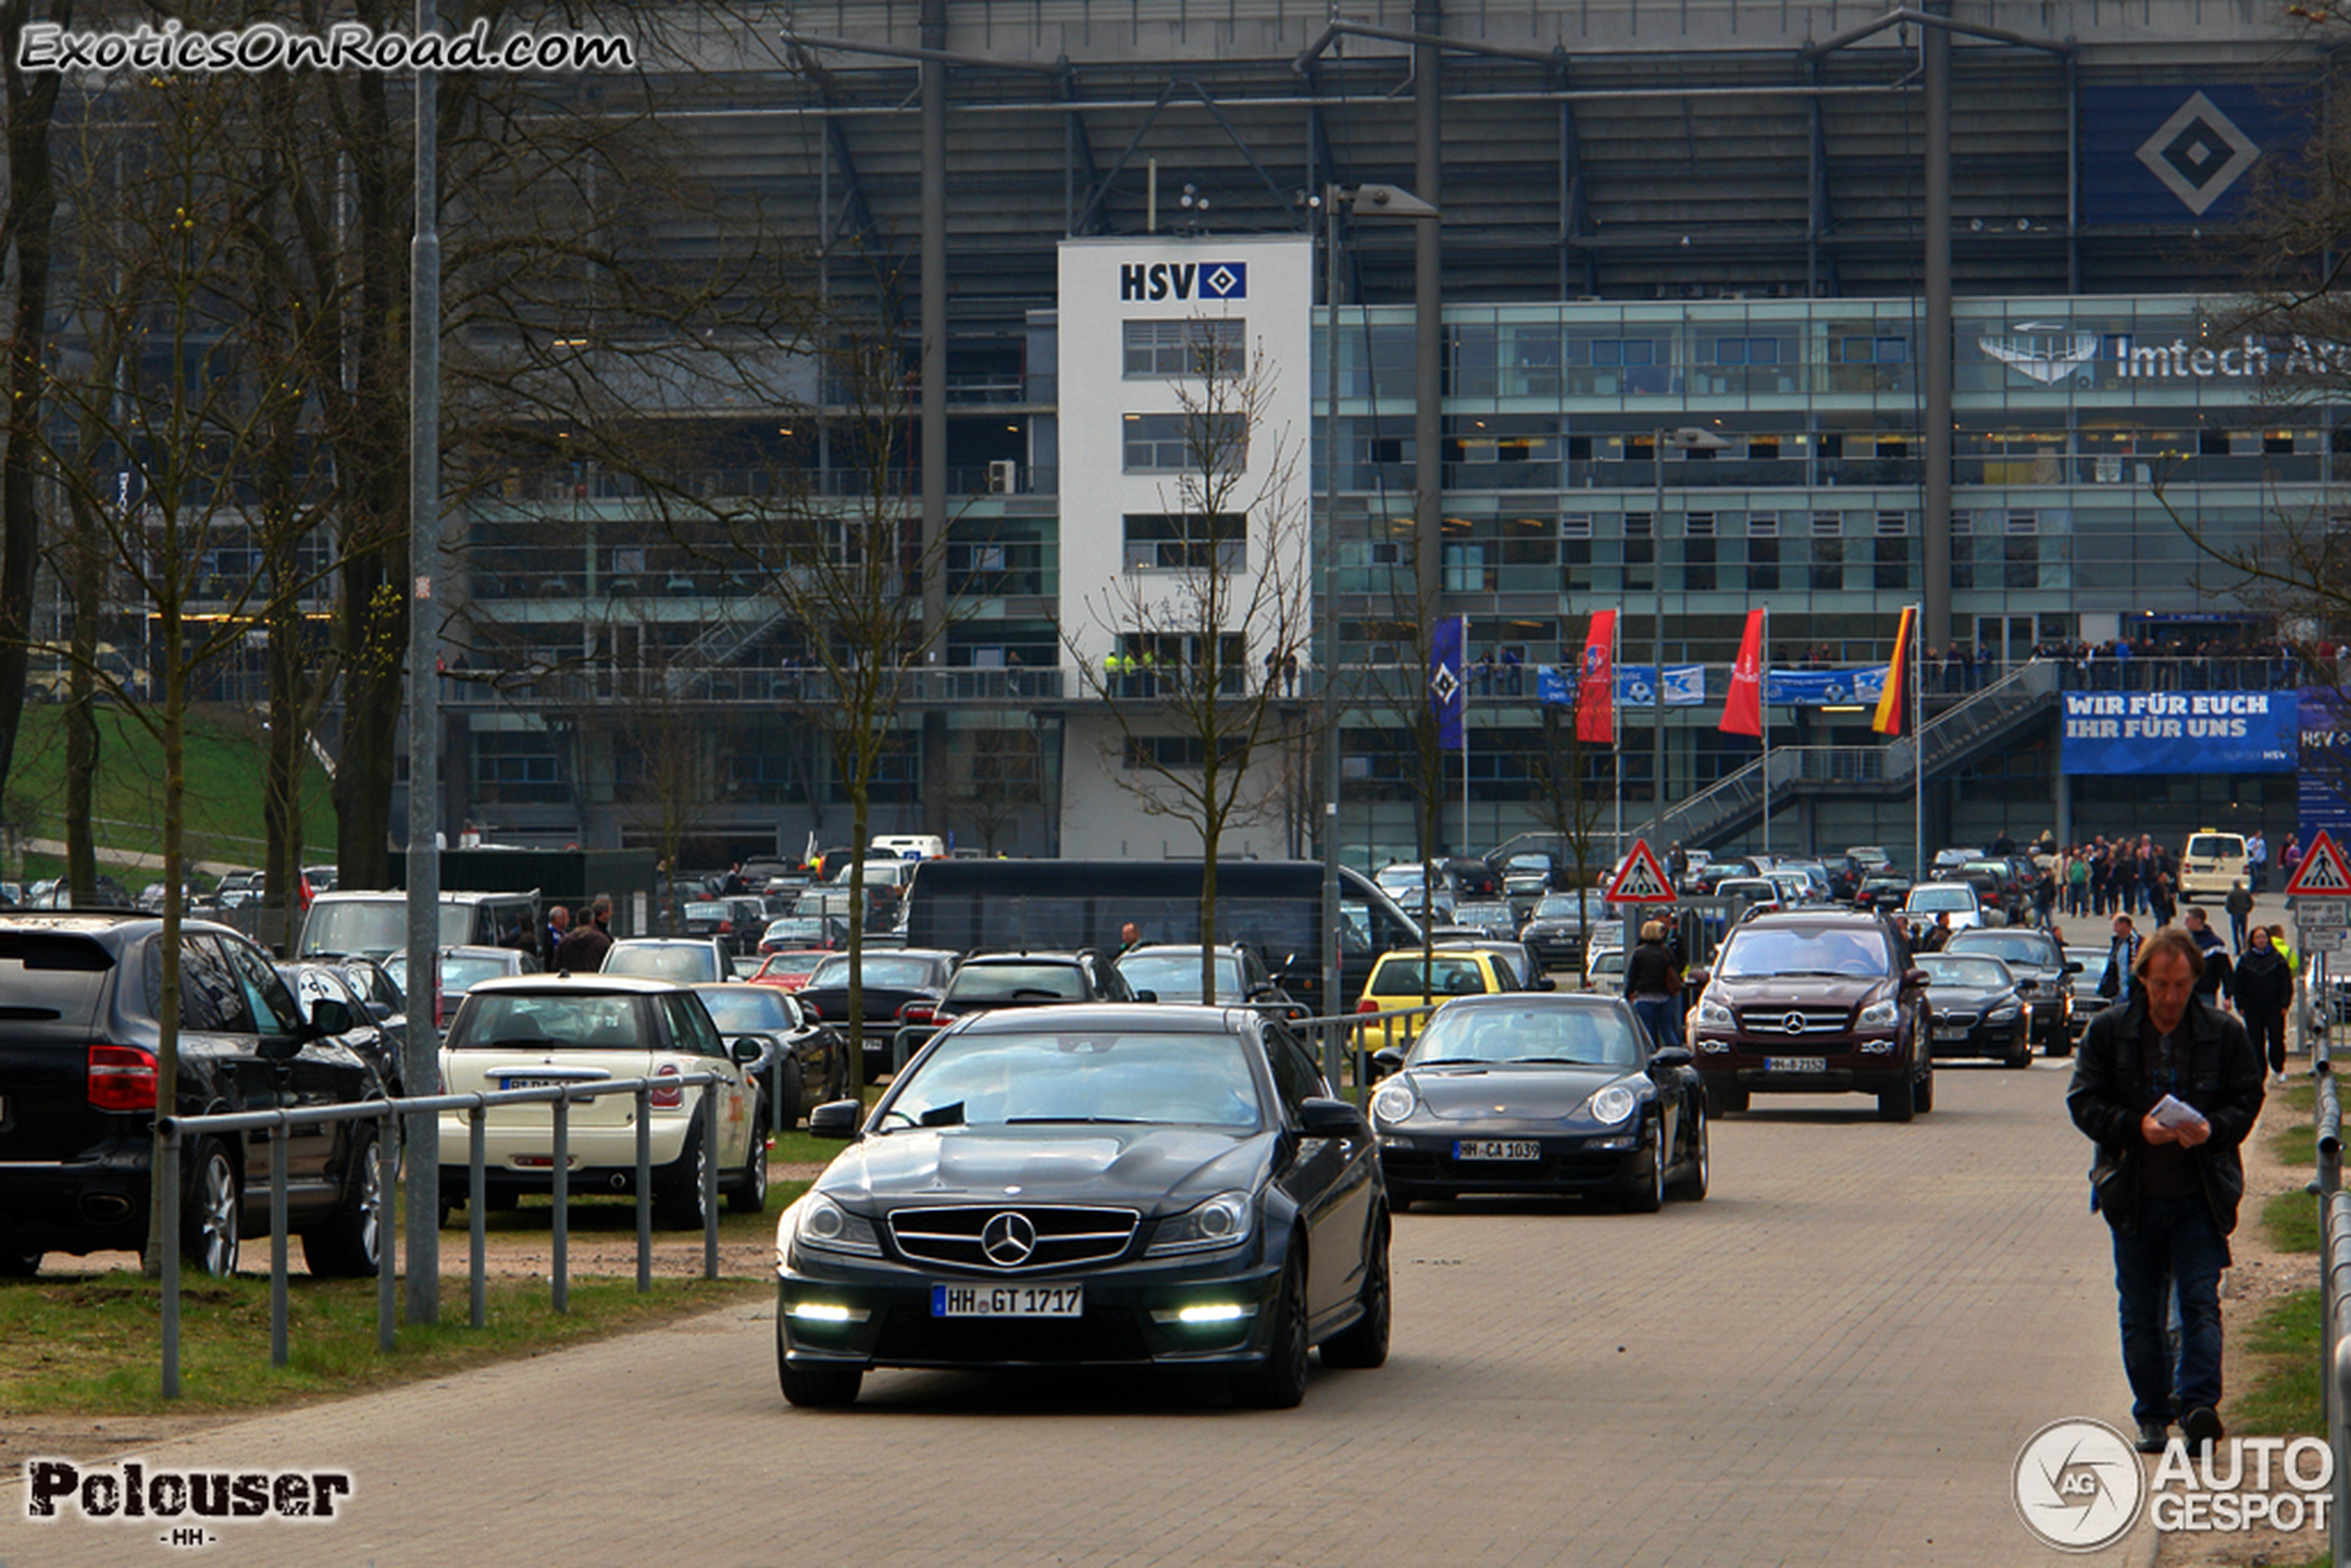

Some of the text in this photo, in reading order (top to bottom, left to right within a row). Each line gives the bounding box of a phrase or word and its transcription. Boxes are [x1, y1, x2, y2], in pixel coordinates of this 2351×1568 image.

[1121, 264, 1197, 301] HSV
[2118, 335, 2269, 377] Imtech
[2066, 692, 2270, 716] WIR FÜR EUCH
[2066, 716, 2247, 739] IHR FÜR UNS
[2300, 730, 2335, 748] HSV
[2263, 751, 2288, 761] HSV
[1461, 1142, 1540, 1158] HH CA 1039
[948, 1287, 1081, 1313] HH GT 1717
